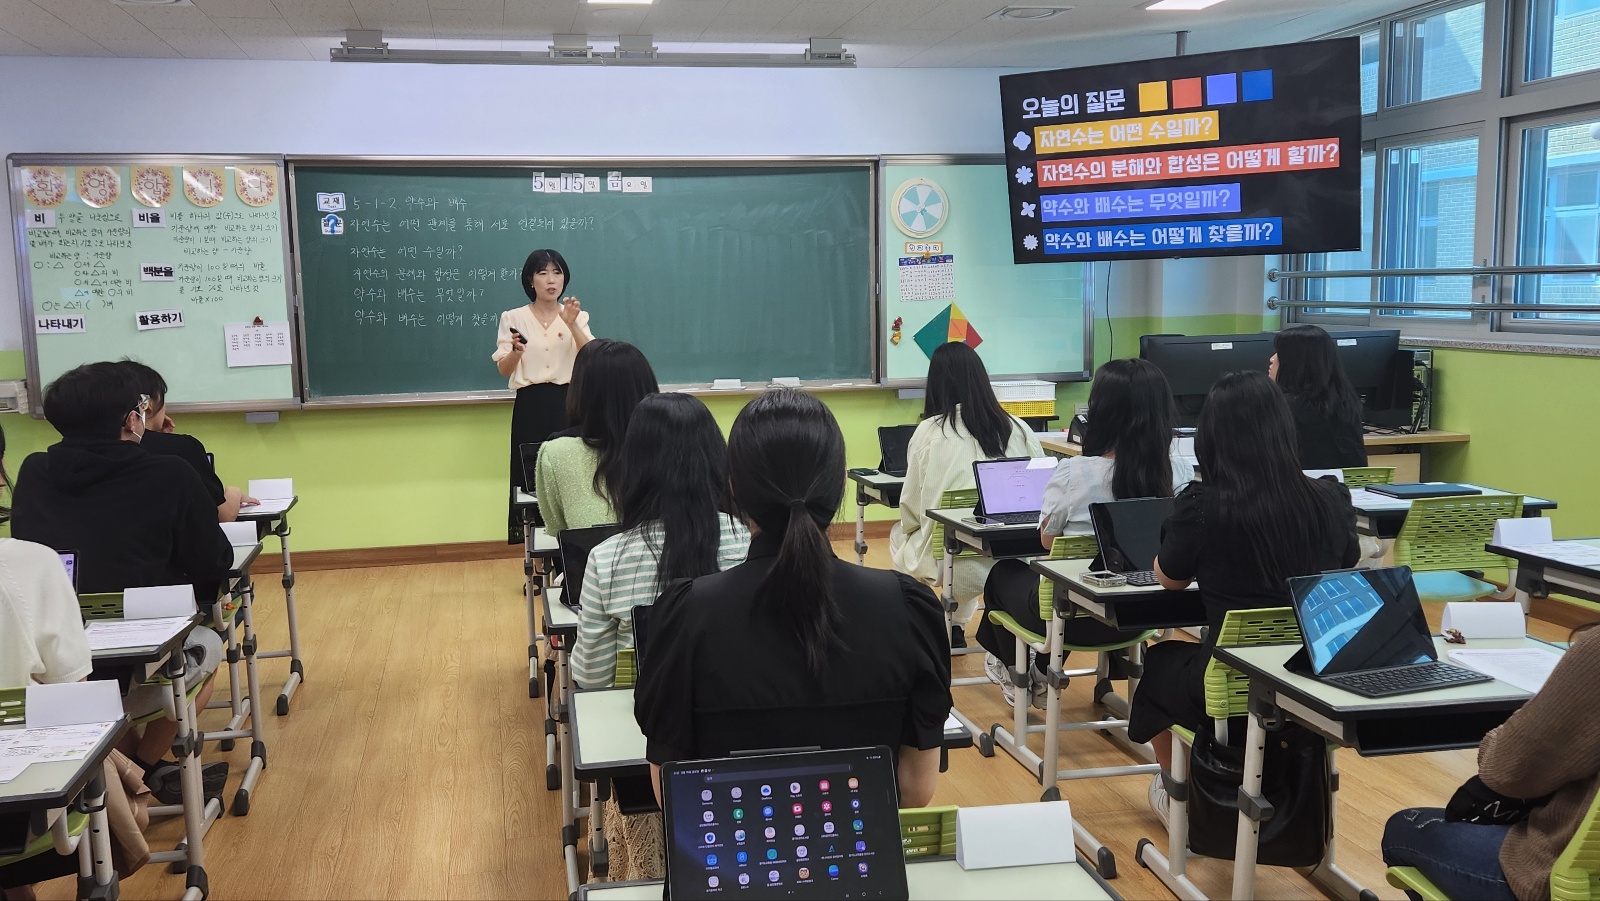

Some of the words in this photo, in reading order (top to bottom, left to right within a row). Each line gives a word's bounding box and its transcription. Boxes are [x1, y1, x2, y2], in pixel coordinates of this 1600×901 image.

[1022, 93, 1079, 119] 오늘의
[1085, 88, 1126, 114] 질문
[1039, 128, 1104, 148] 자연수는
[1110, 122, 1143, 142] 어떤
[1148, 116, 1213, 139] 수일까?
[1042, 160, 1106, 182] 자연수의
[1111, 157, 1162, 178] 분해와
[1167, 152, 1220, 174] 합성은
[1226, 147, 1281, 169] 어떻게
[1288, 142, 1339, 165] 할까?
[405, 195, 439, 211] 약수와
[448, 197, 468, 212] 배수
[1043, 197, 1089, 217] 약수와
[1095, 195, 1144, 213] 배수는
[1150, 189, 1231, 211] 무엇일까?
[34, 213, 46, 224] 비
[138, 212, 161, 224] 비율
[349, 218, 391, 233] 자연수는
[398, 218, 420, 231] 어떤
[427, 216, 457, 232] 관계를
[464, 217, 484, 232] 통해
[490, 218, 509, 231] 서로
[1045, 231, 1092, 250] 약수와
[1097, 230, 1147, 249] 배수는
[1152, 225, 1202, 245] 어떻게
[1208, 222, 1274, 244] 찾을까?
[350, 245, 387, 259] 자연수는
[422, 244, 463, 260] 수일까?
[142, 266, 174, 277] 백분율
[353, 267, 388, 281] 자연수의
[395, 267, 426, 281] 분해와
[434, 267, 460, 281] 합성은
[468, 267, 496, 281] 어떻게
[353, 287, 387, 303] 약수와
[397, 287, 426, 303] 배수는
[38, 318, 84, 330] 나타내기
[138, 312, 183, 326] 활용하기
[354, 309, 388, 326] 약수와
[398, 313, 427, 327] 배수는
[436, 312, 463, 327] 어떻게
